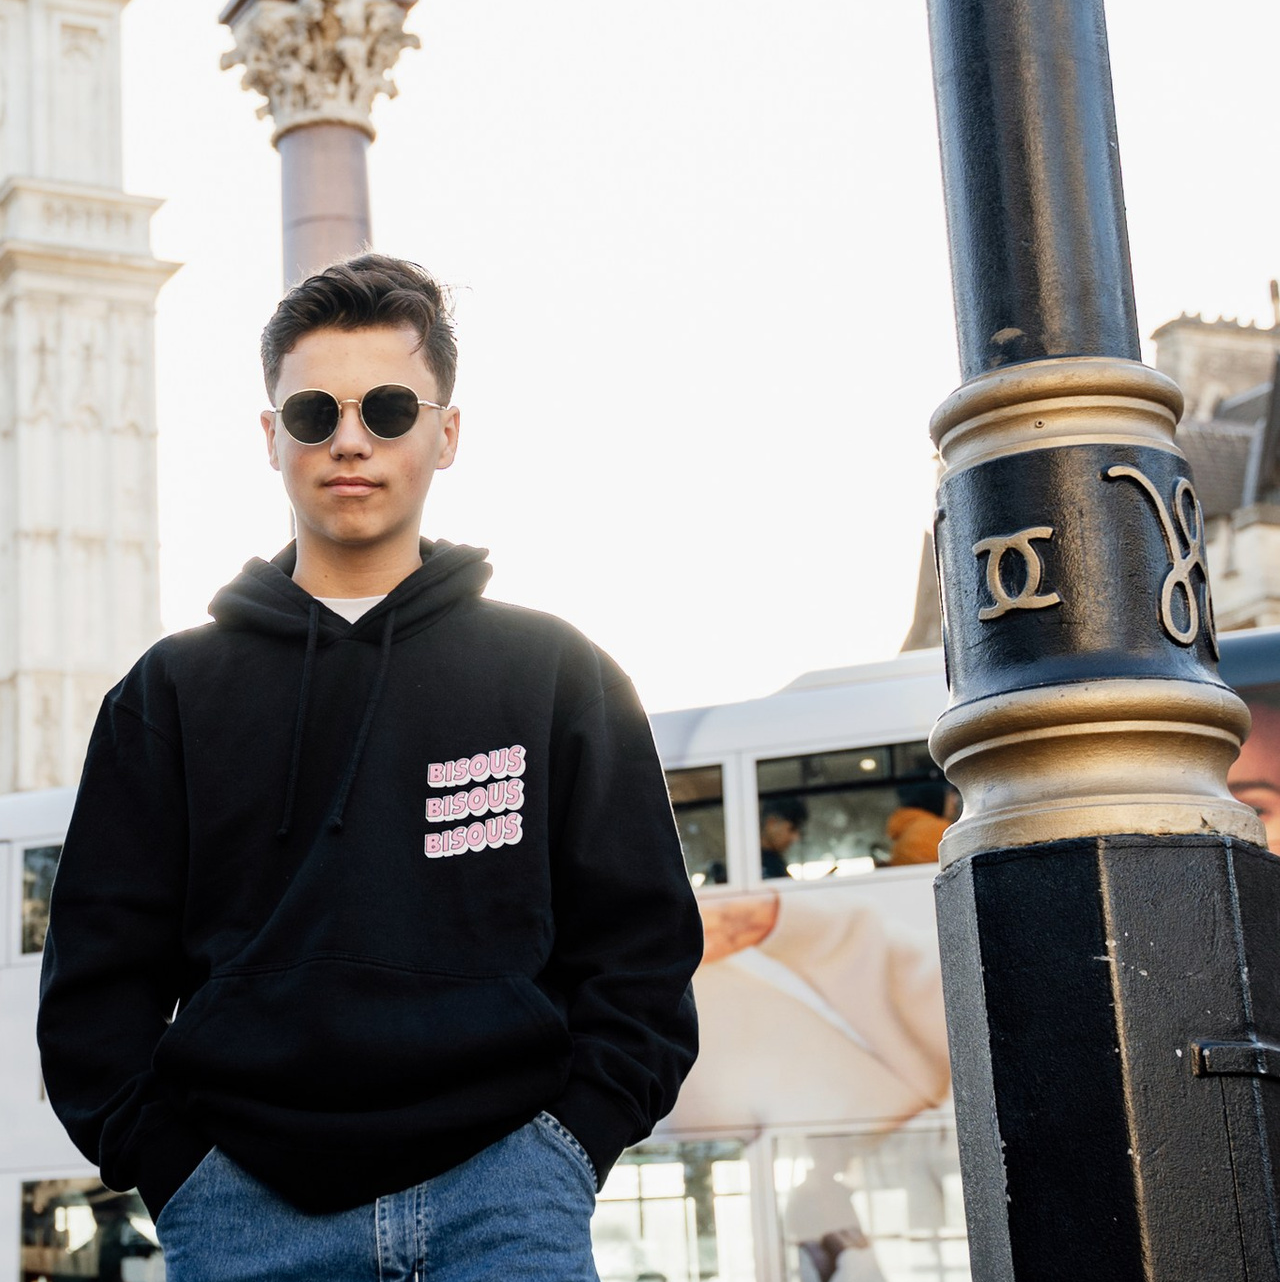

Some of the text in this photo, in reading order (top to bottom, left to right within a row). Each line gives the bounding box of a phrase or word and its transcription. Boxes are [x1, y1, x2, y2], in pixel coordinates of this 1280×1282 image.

[427, 745, 526, 787] BISOUS
[426, 778, 524, 822] BISOUS
[425, 812, 523, 858] BISOUS
